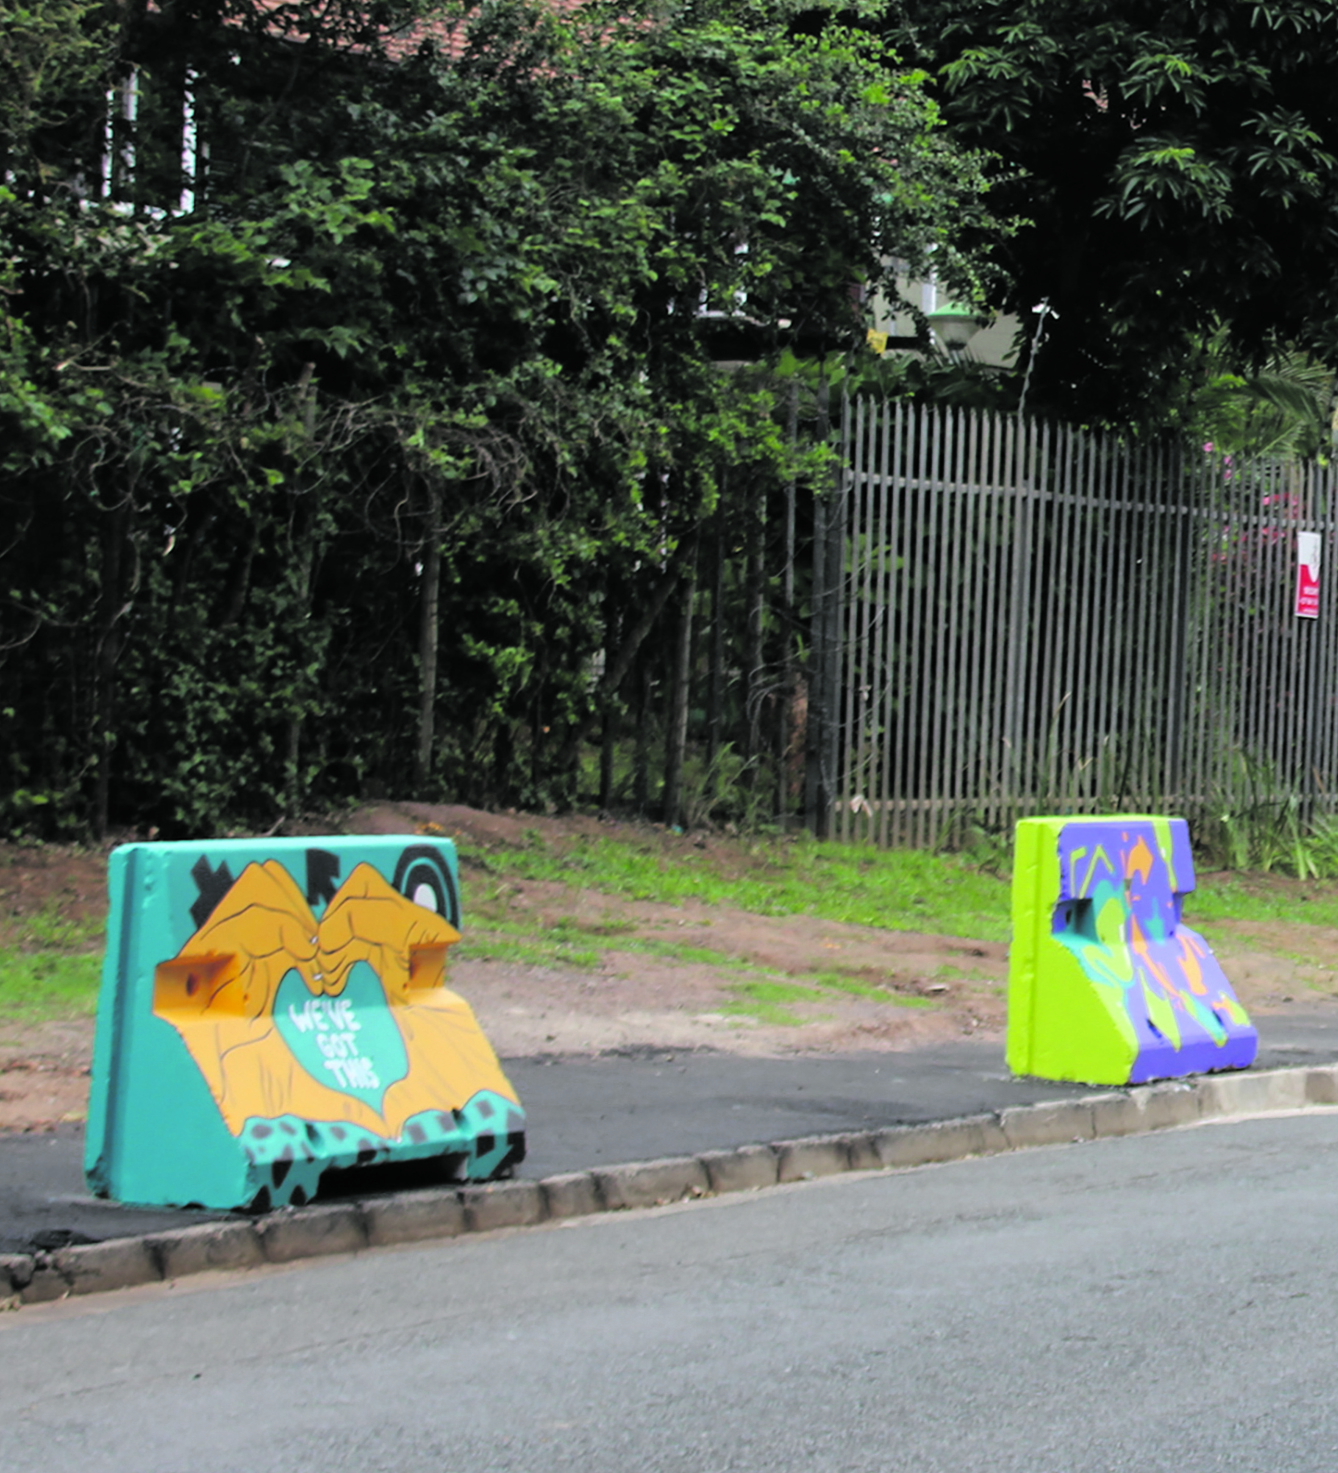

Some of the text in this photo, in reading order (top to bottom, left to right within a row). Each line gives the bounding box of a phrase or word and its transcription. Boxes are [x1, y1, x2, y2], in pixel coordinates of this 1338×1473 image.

[289, 1000, 361, 1032] WE'VE
[316, 1033, 358, 1058] GOT
[324, 1057, 379, 1088] THIS
